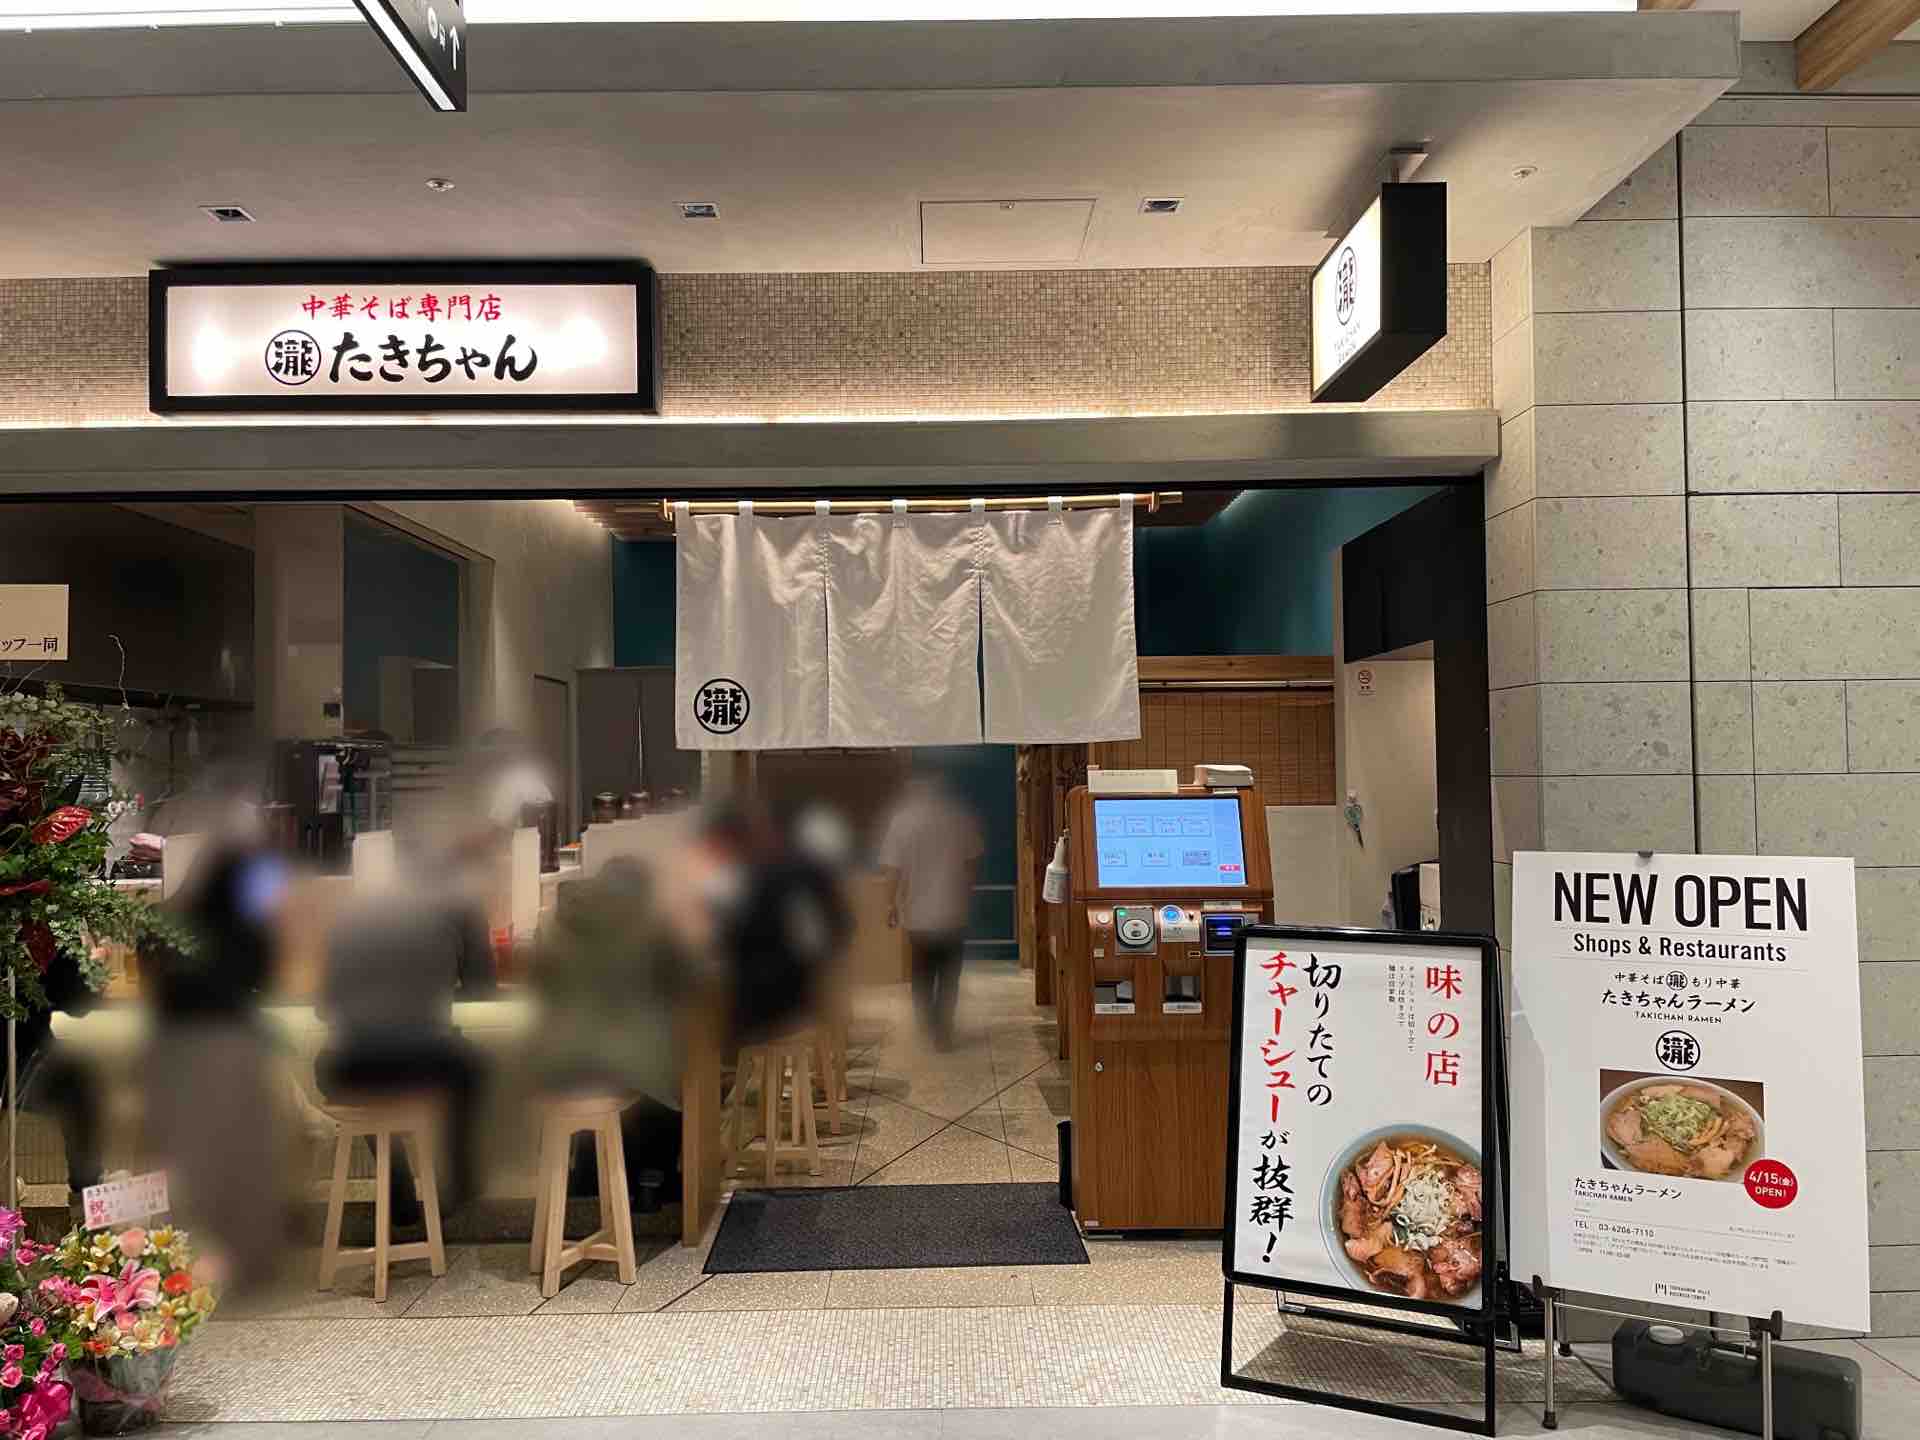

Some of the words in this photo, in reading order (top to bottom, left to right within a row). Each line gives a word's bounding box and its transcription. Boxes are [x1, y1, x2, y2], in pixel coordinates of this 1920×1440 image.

[302, 294, 502, 321] 中華そば専門店
[329, 332, 538, 383] たきちゃん
[1554, 872, 1658, 925] NEW
[1674, 875, 1808, 931] OPEN
[1574, 933, 1632, 957] Shops
[1639, 936, 1652, 955] &
[1660, 937, 1787, 962] Restaurants
[1614, 971, 1664, 985] 中華そば
[1691, 976, 1741, 989] もり中華
[1601, 989, 1757, 1013] たきちゃんラーメン
[1303, 953, 1342, 1106] 切りたての
[1425, 964, 1463, 1087] 味の店
[1635, 1011, 1684, 1021] TAKICHAN
[1688, 1015, 1722, 1024] RAMEN
[1575, 1177, 1682, 1199] たきちゃんラーメン
[1755, 1186, 1786, 1198] OPEN!
